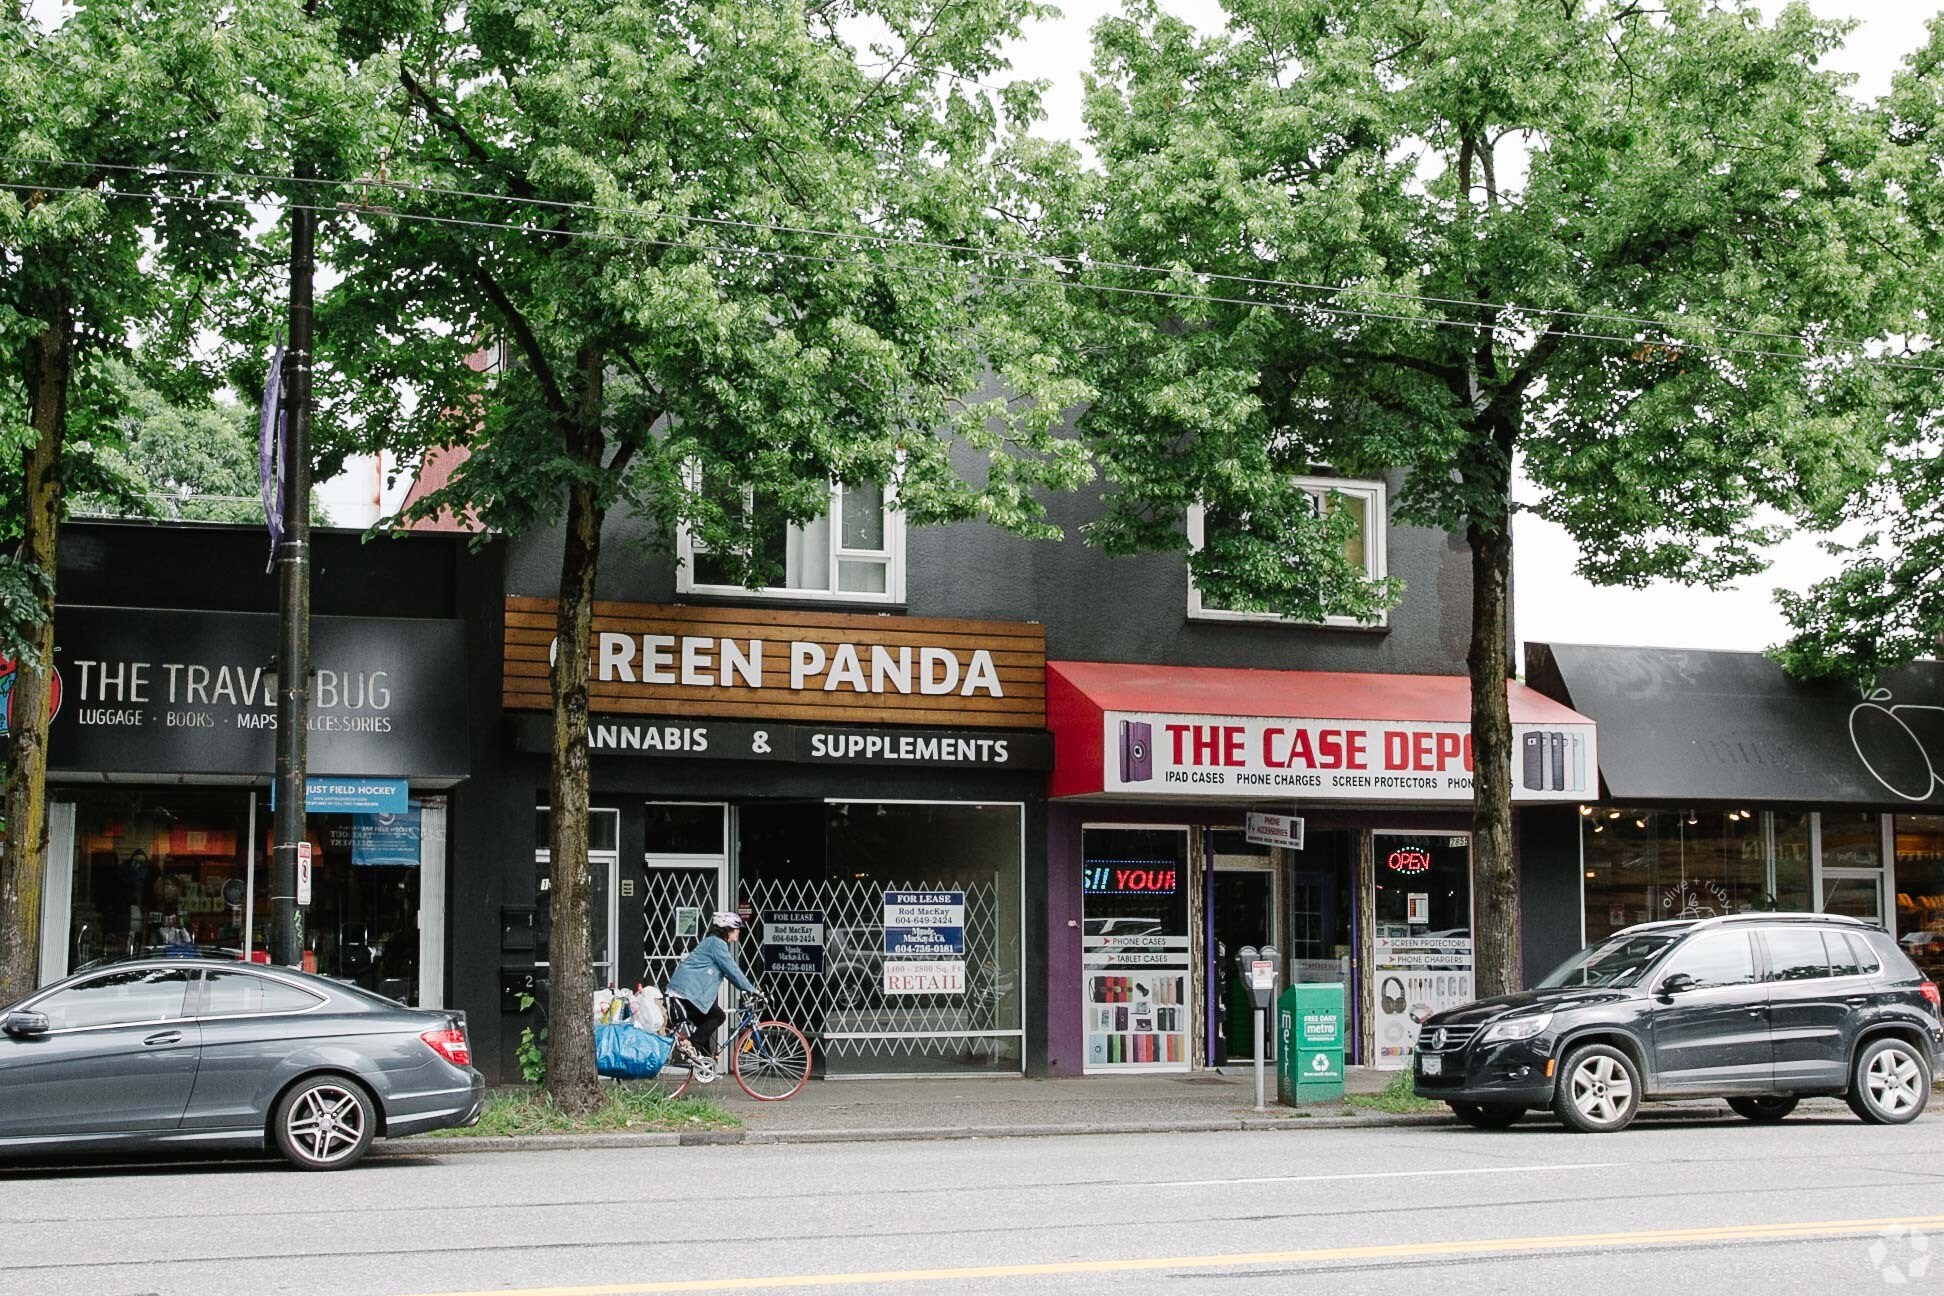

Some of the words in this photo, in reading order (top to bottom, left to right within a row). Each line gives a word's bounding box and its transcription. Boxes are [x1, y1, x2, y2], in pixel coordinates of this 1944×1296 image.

[550, 632, 762, 688] REEN
[790, 641, 1004, 698] PANDA
[74, 660, 150, 703] THE
[317, 669, 391, 710] BUG
[79, 709, 143, 726] LUGGAGE
[166, 711, 215, 728] BOOKS
[237, 713, 278, 729] MAPS
[752, 730, 772, 753] &
[811, 732, 1009, 763] SUPPLEMENTS
[1165, 724, 1246, 767] THE
[1262, 727, 1368, 771] CASE
[1165, 771, 1189, 784] IPAD
[1191, 771, 1225, 785] CASES
[1236, 773, 1271, 786] PHONE
[1274, 774, 1321, 788] CHARGES
[1332, 775, 1371, 788] SCREEN
[1374, 776, 1438, 790] PROTECTORS
[306, 785, 328, 795] JUST
[329, 785, 355, 795] FIELD
[358, 786, 397, 795] HOCKEY
[1388, 852, 1431, 870] OPEN
[897, 894, 918, 903] FOR
[919, 894, 952, 904] LEASE
[1662, 879, 1689, 909] olive
[1704, 878, 1732, 910] ruby
[773, 913, 789, 921] FOR
[790, 913, 814, 921] LEASE
[899, 907, 915, 915] Rod
[917, 907, 950, 918] MacKay
[527, 913, 534, 927] 1
[895, 916, 953, 924] 604-649-2424
[1112, 937, 1140, 946] PHONE
[1142, 937, 1167, 946] CASES
[1390, 939, 1418, 947] SCREEN
[1420, 939, 1466, 947] PROTECTORS
[894, 944, 954, 953] 604-736-0181
[1116, 955, 1142, 963] TABLET
[1143, 955, 1168, 963] CASES
[1397, 956, 1422, 964] PHONE
[1424, 956, 1463, 964] CHARGERS
[913, 964, 933, 973] 2800
[525, 975, 534, 988] 2
[888, 975, 962, 991] RETAIL
[1306, 1024, 1335, 1035] metro
